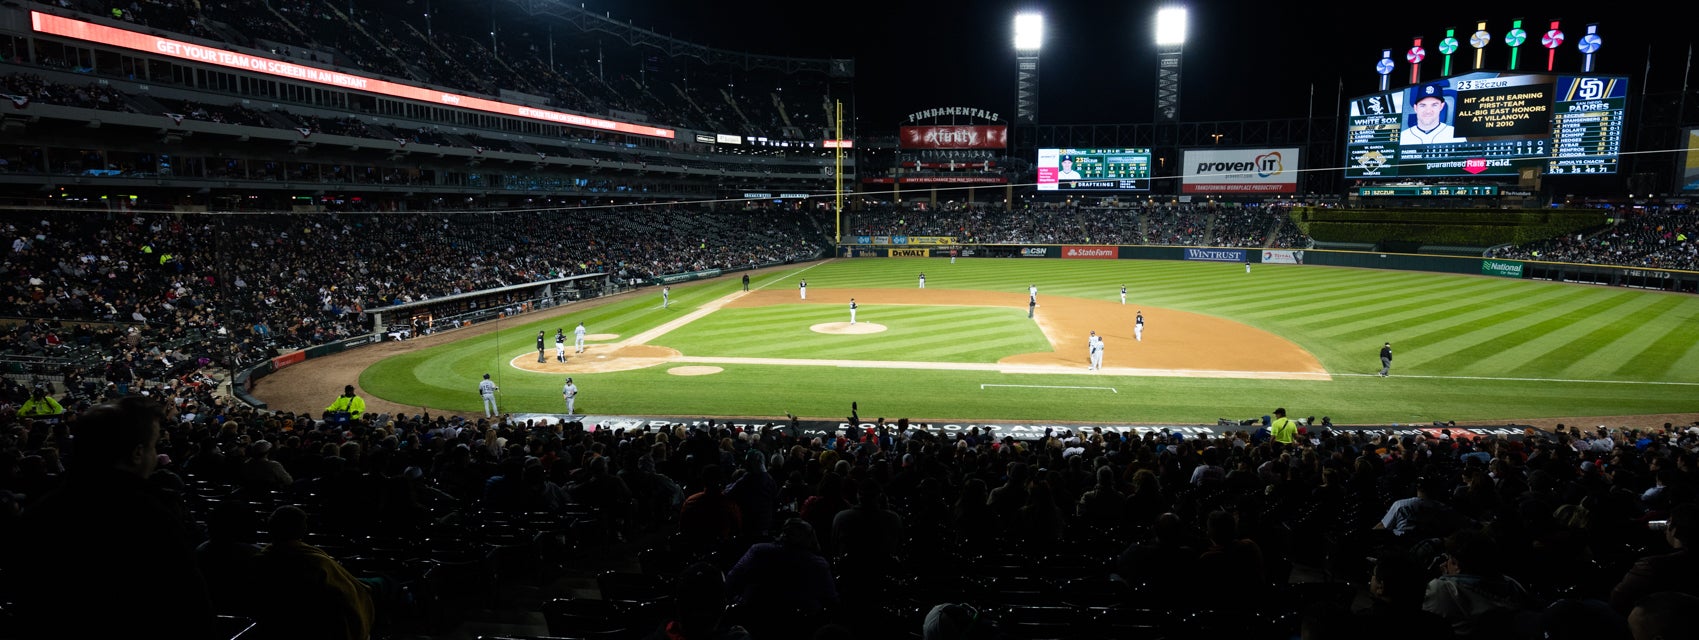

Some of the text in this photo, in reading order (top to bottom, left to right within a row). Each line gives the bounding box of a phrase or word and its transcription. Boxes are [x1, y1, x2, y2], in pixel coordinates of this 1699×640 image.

[157, 40, 366, 88] GET YOUR TEAM ON SCREEN IN AN INSTANT
[1458, 81, 1472, 90] 23
[1580, 78, 1603, 100] SD
[1507, 92, 1543, 100] EARNING
[1480, 100, 1524, 108] FIRST-TEAM
[1570, 104, 1609, 112] PADRES
[530, 108, 544, 118] YOUR
[544, 111, 558, 120] TEAM
[909, 107, 999, 122] FUNDAMENTALS
[930, 130, 977, 146] xfinity
[1197, 160, 1276, 174] proven IT
[1426, 161, 1466, 169] guaranteed
[1486, 159, 1512, 167] Field.
[1189, 249, 1242, 259] WINTRUST
[1491, 262, 1522, 271] National
